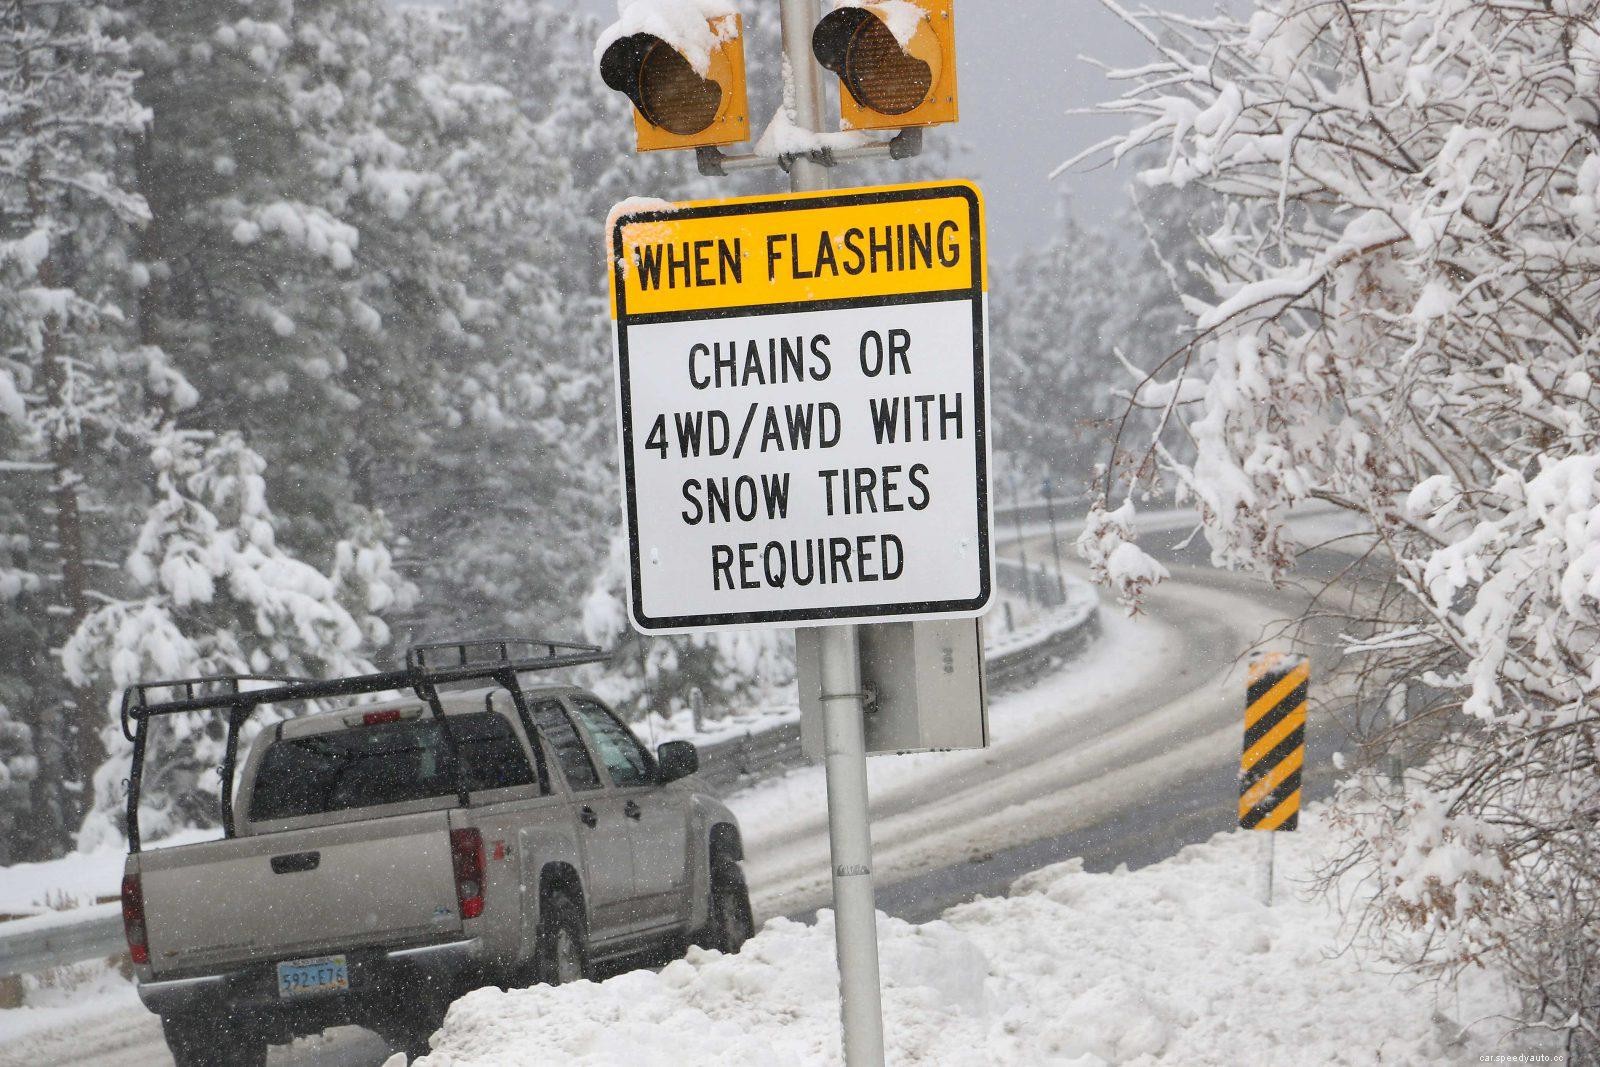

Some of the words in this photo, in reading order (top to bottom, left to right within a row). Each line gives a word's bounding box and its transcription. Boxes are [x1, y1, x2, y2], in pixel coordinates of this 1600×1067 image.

[634, 238, 742, 291] WHEN
[766, 219, 960, 282] FLASHING
[688, 333, 831, 390] CHAINS
[859, 328, 912, 378] OR
[644, 402, 841, 460] 4WD/AWD
[869, 392, 963, 445] WITH
[681, 472, 790, 526] SNOW
[818, 463, 930, 516] TIRES
[711, 533, 904, 591] REQUIRED
